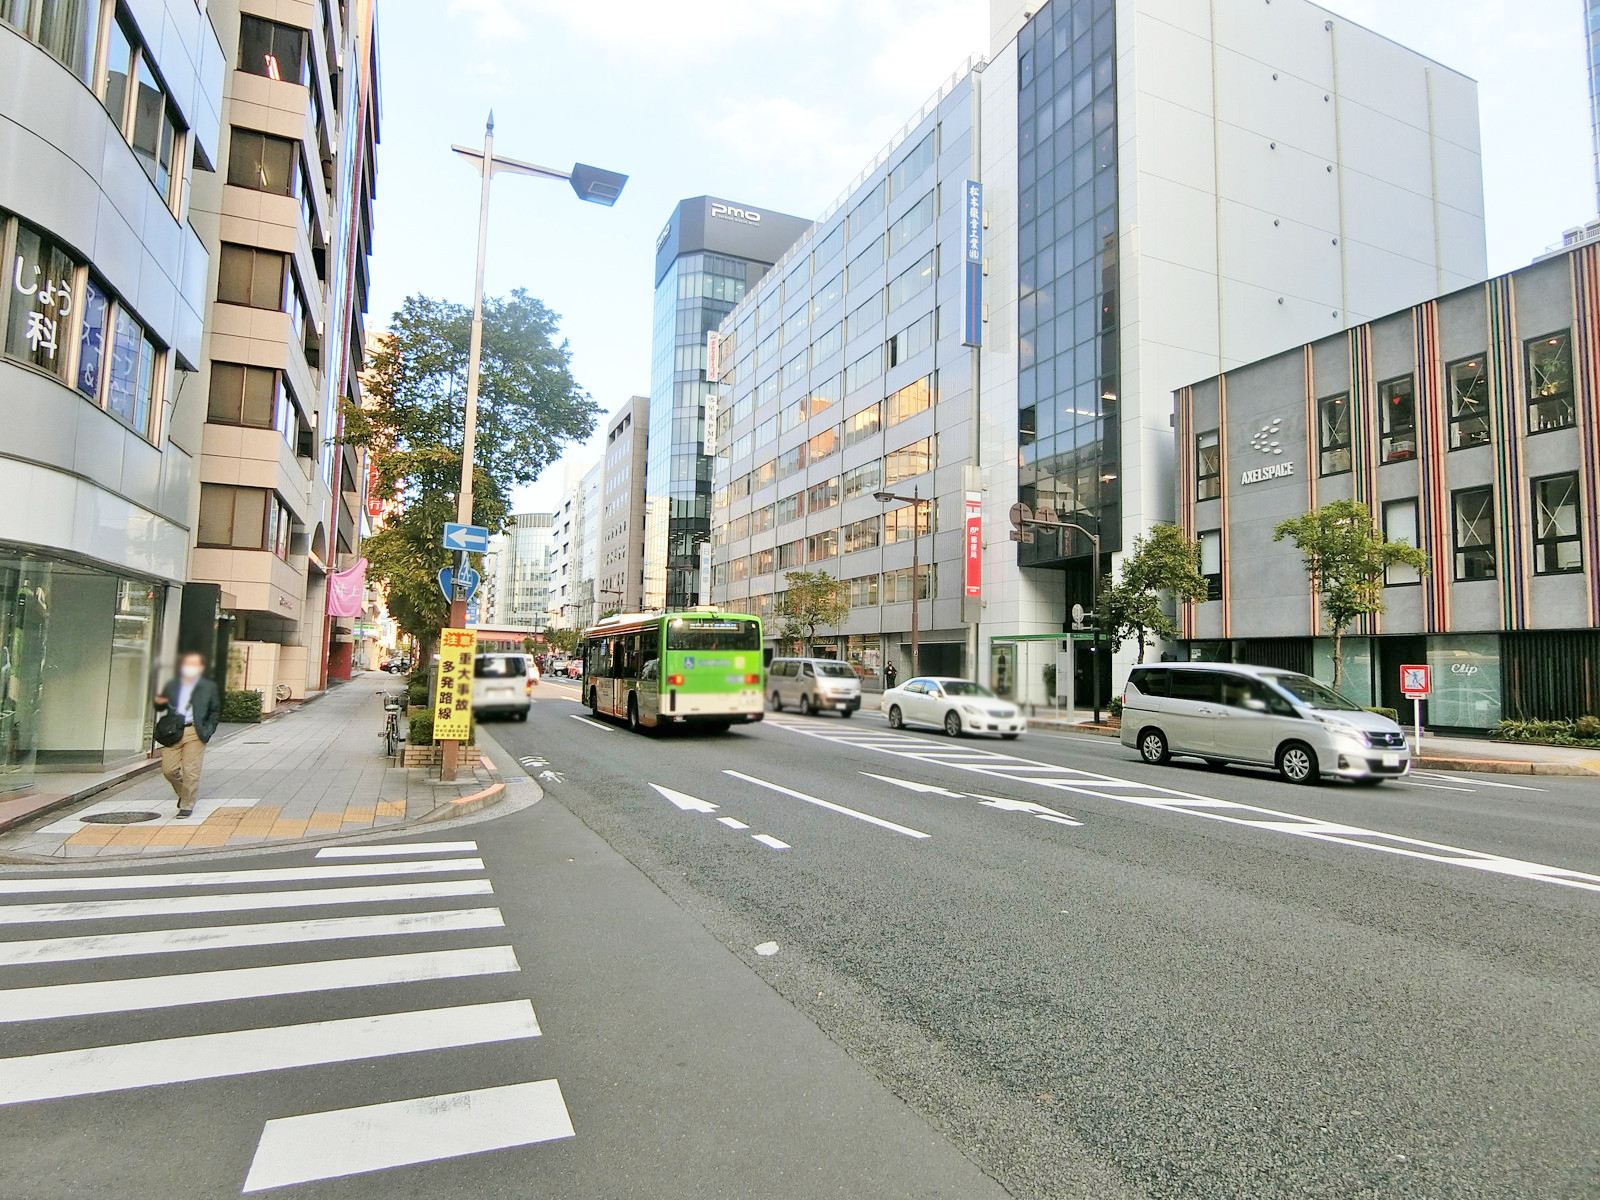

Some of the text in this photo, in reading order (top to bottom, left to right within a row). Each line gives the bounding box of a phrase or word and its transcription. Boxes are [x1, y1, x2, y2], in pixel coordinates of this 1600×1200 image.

[16, 255, 71, 316] じょう
[26, 311, 57, 359] 科
[1241, 462, 1294, 485] AXELSPACE
[445, 635, 470, 646] 注意
[438, 660, 455, 720] 多発路線
[456, 652, 471, 711] 重大事故
[1451, 663, 1478, 676] Clip
